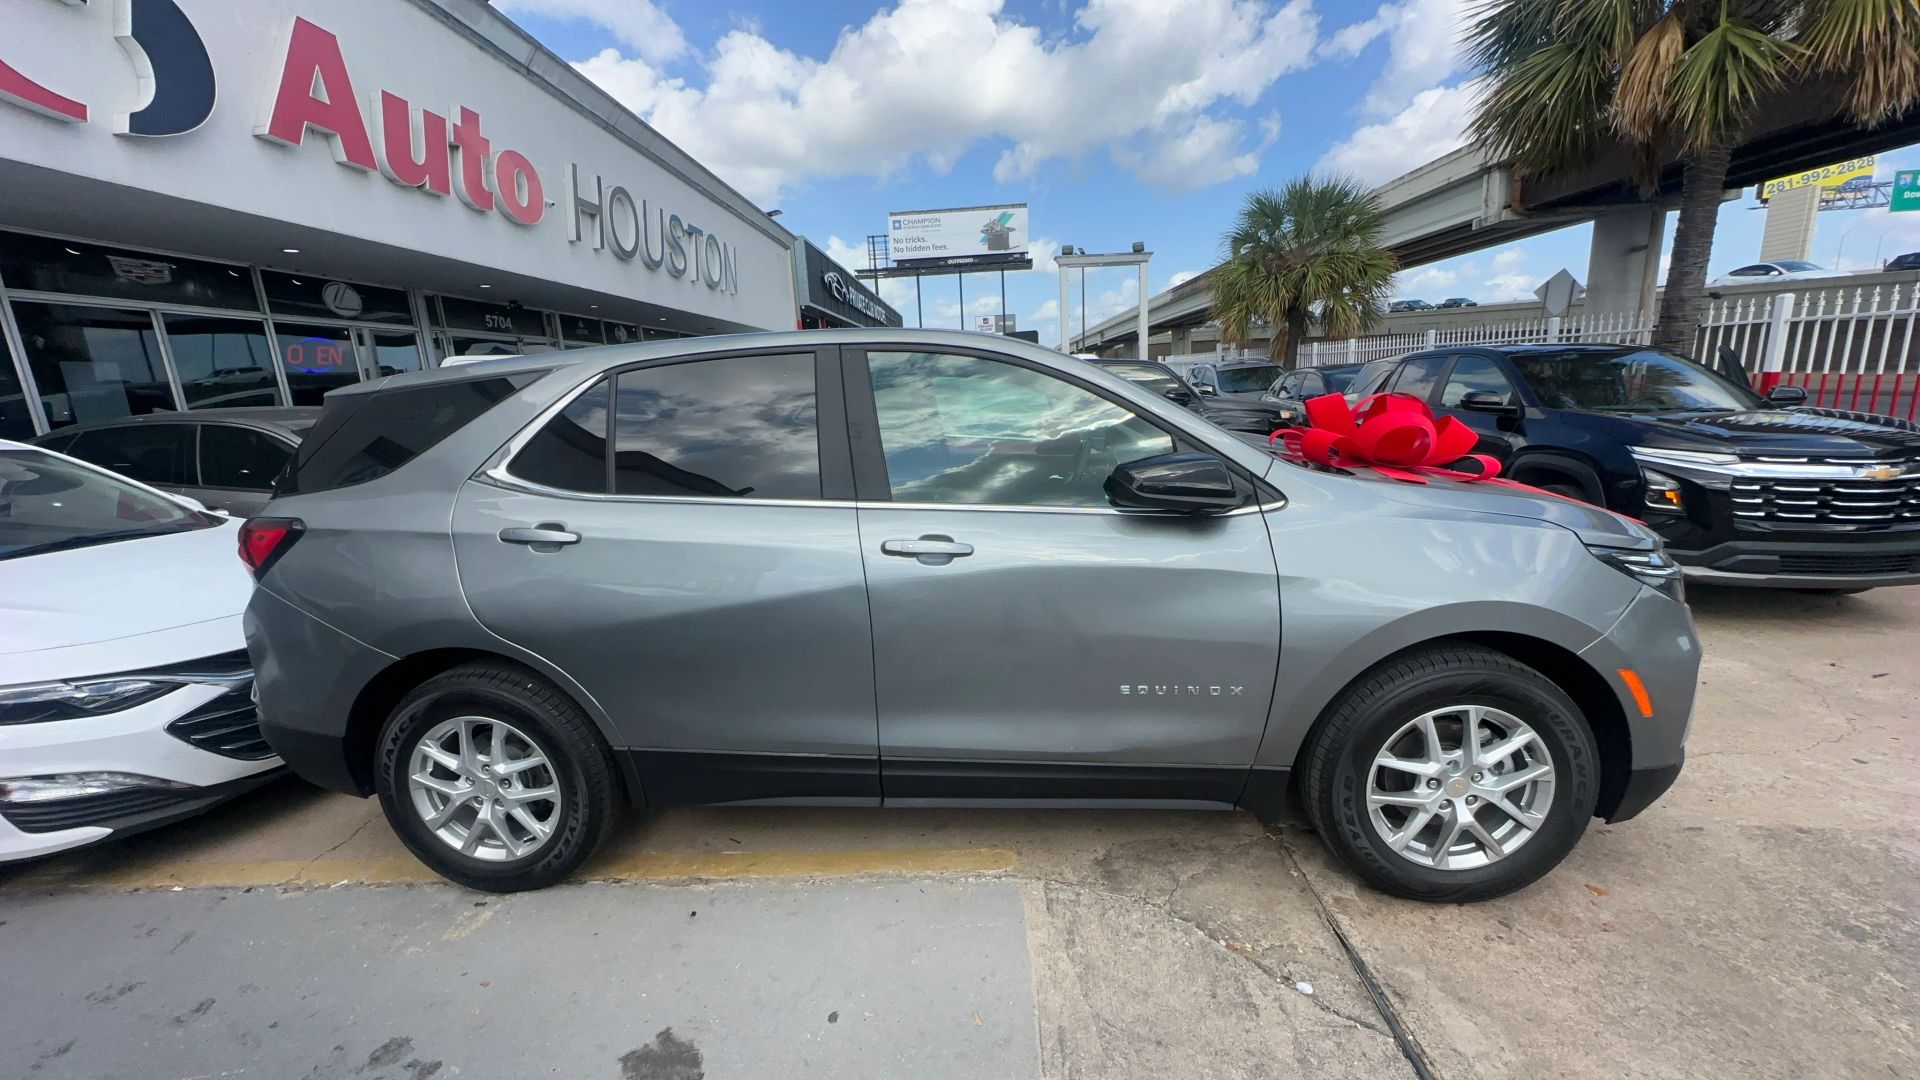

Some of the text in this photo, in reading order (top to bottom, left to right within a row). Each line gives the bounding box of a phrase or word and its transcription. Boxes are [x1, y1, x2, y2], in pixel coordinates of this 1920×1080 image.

[255, 15, 545, 225] Auto
[567, 162, 738, 295] HOUSTON
[1766, 155, 1876, 195] 281-992-2828
[902, 216, 942, 226] CHAMPION
[893, 235, 927, 245] No tricks.
[893, 243, 950, 253] No hidden fees.
[485, 314, 513, 329] 5704
[286, 343, 344, 366] OEN
[1120, 684, 1244, 696] EQUINOX
